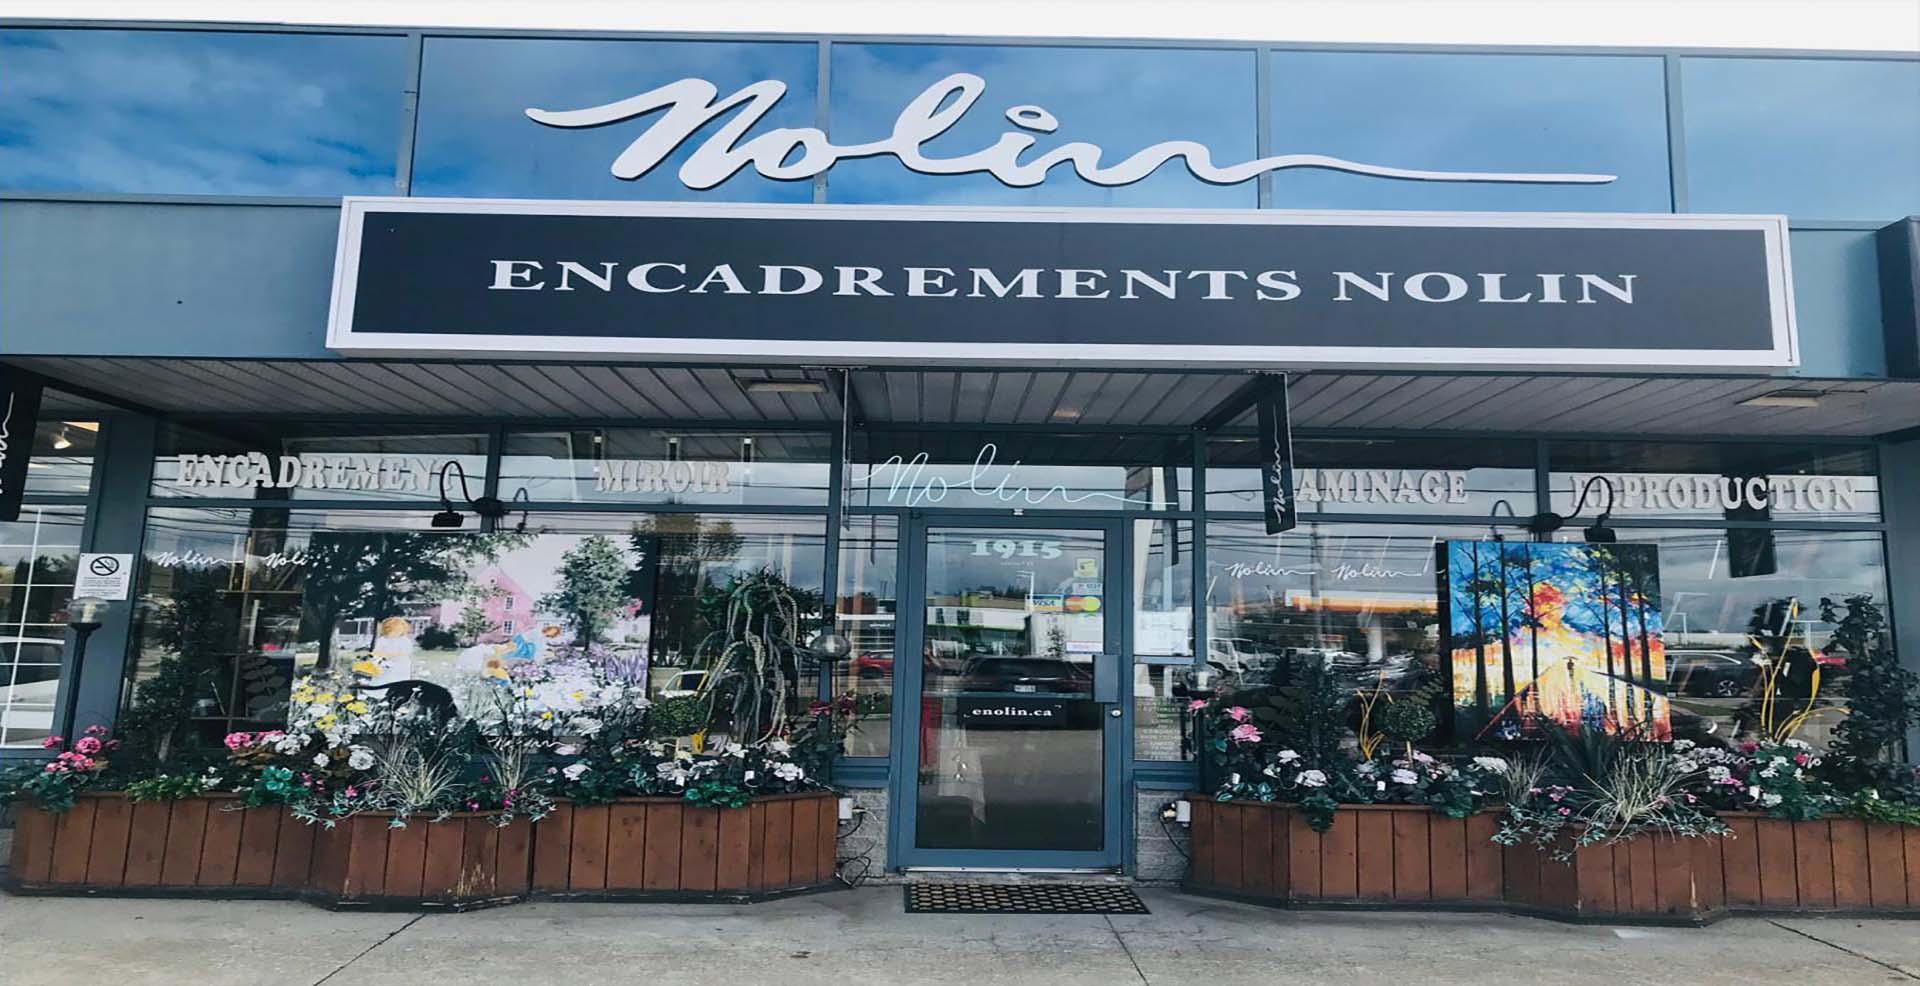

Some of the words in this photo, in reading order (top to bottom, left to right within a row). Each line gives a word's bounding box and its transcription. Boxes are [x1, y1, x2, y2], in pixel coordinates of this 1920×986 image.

[490, 259, 1301, 301] ENCADREMENTS
[1332, 270, 1637, 305] NOLIN
[592, 460, 731, 494] MIROIR
[1294, 467, 1470, 504] AMINAGE
[970, 539, 1063, 559] 1915
[971, 706, 1052, 717] enolin.ca
